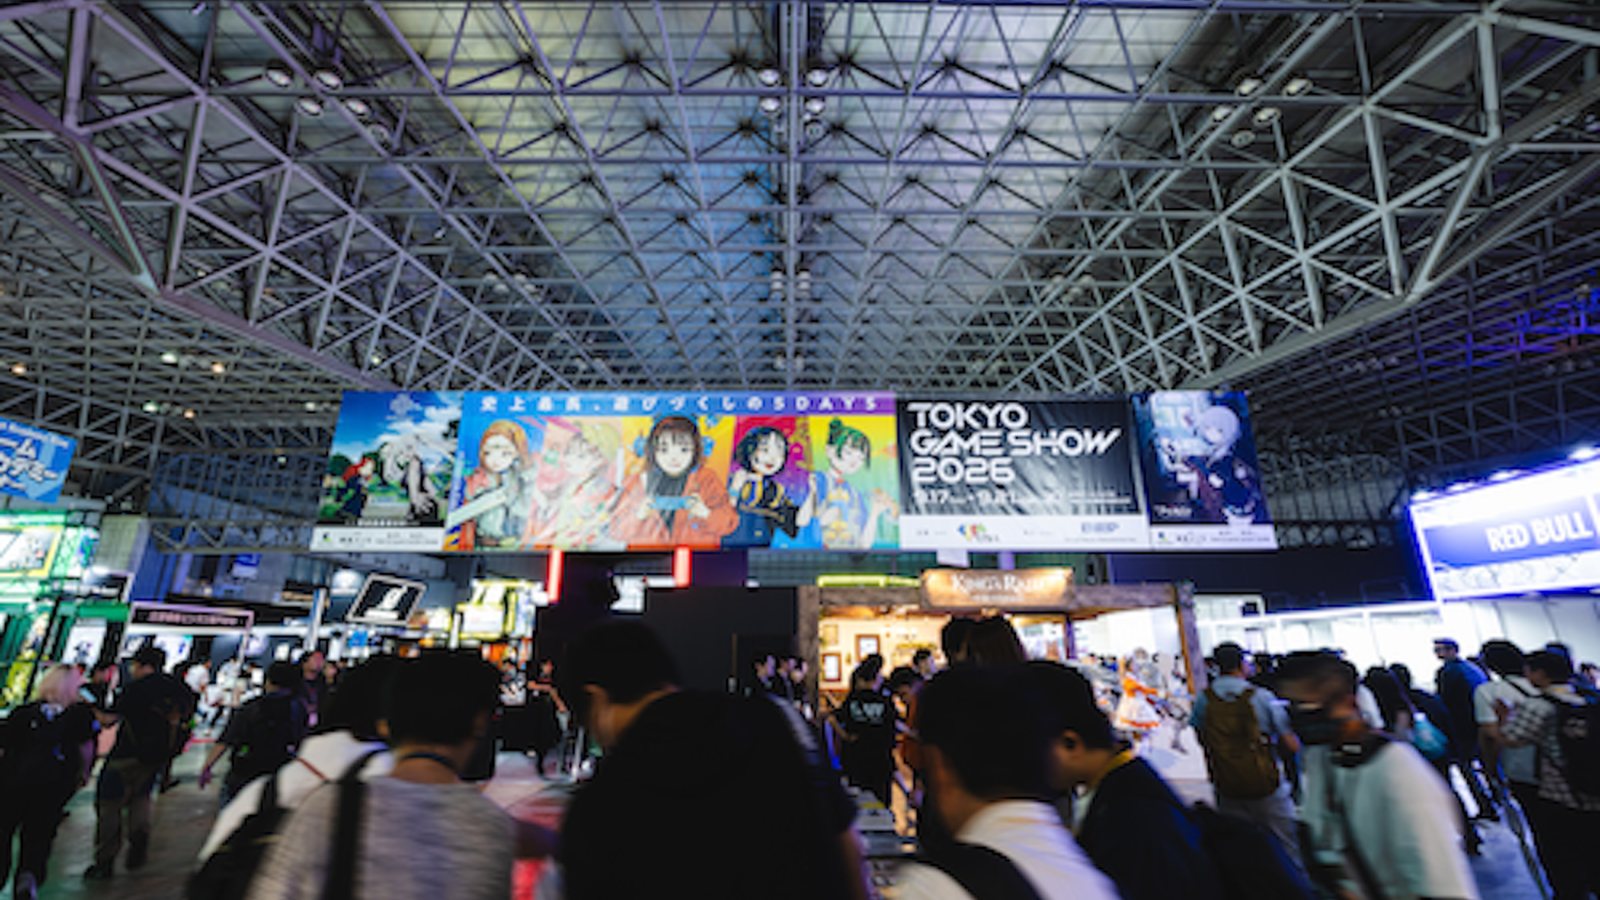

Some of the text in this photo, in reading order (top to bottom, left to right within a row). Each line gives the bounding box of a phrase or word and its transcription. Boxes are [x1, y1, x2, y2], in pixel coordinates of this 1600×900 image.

[907, 402, 1028, 430] TOKYO
[910, 428, 1122, 457] GAME SHOW
[912, 457, 1016, 484] 2026
[1486, 512, 1594, 552] RED BULL
